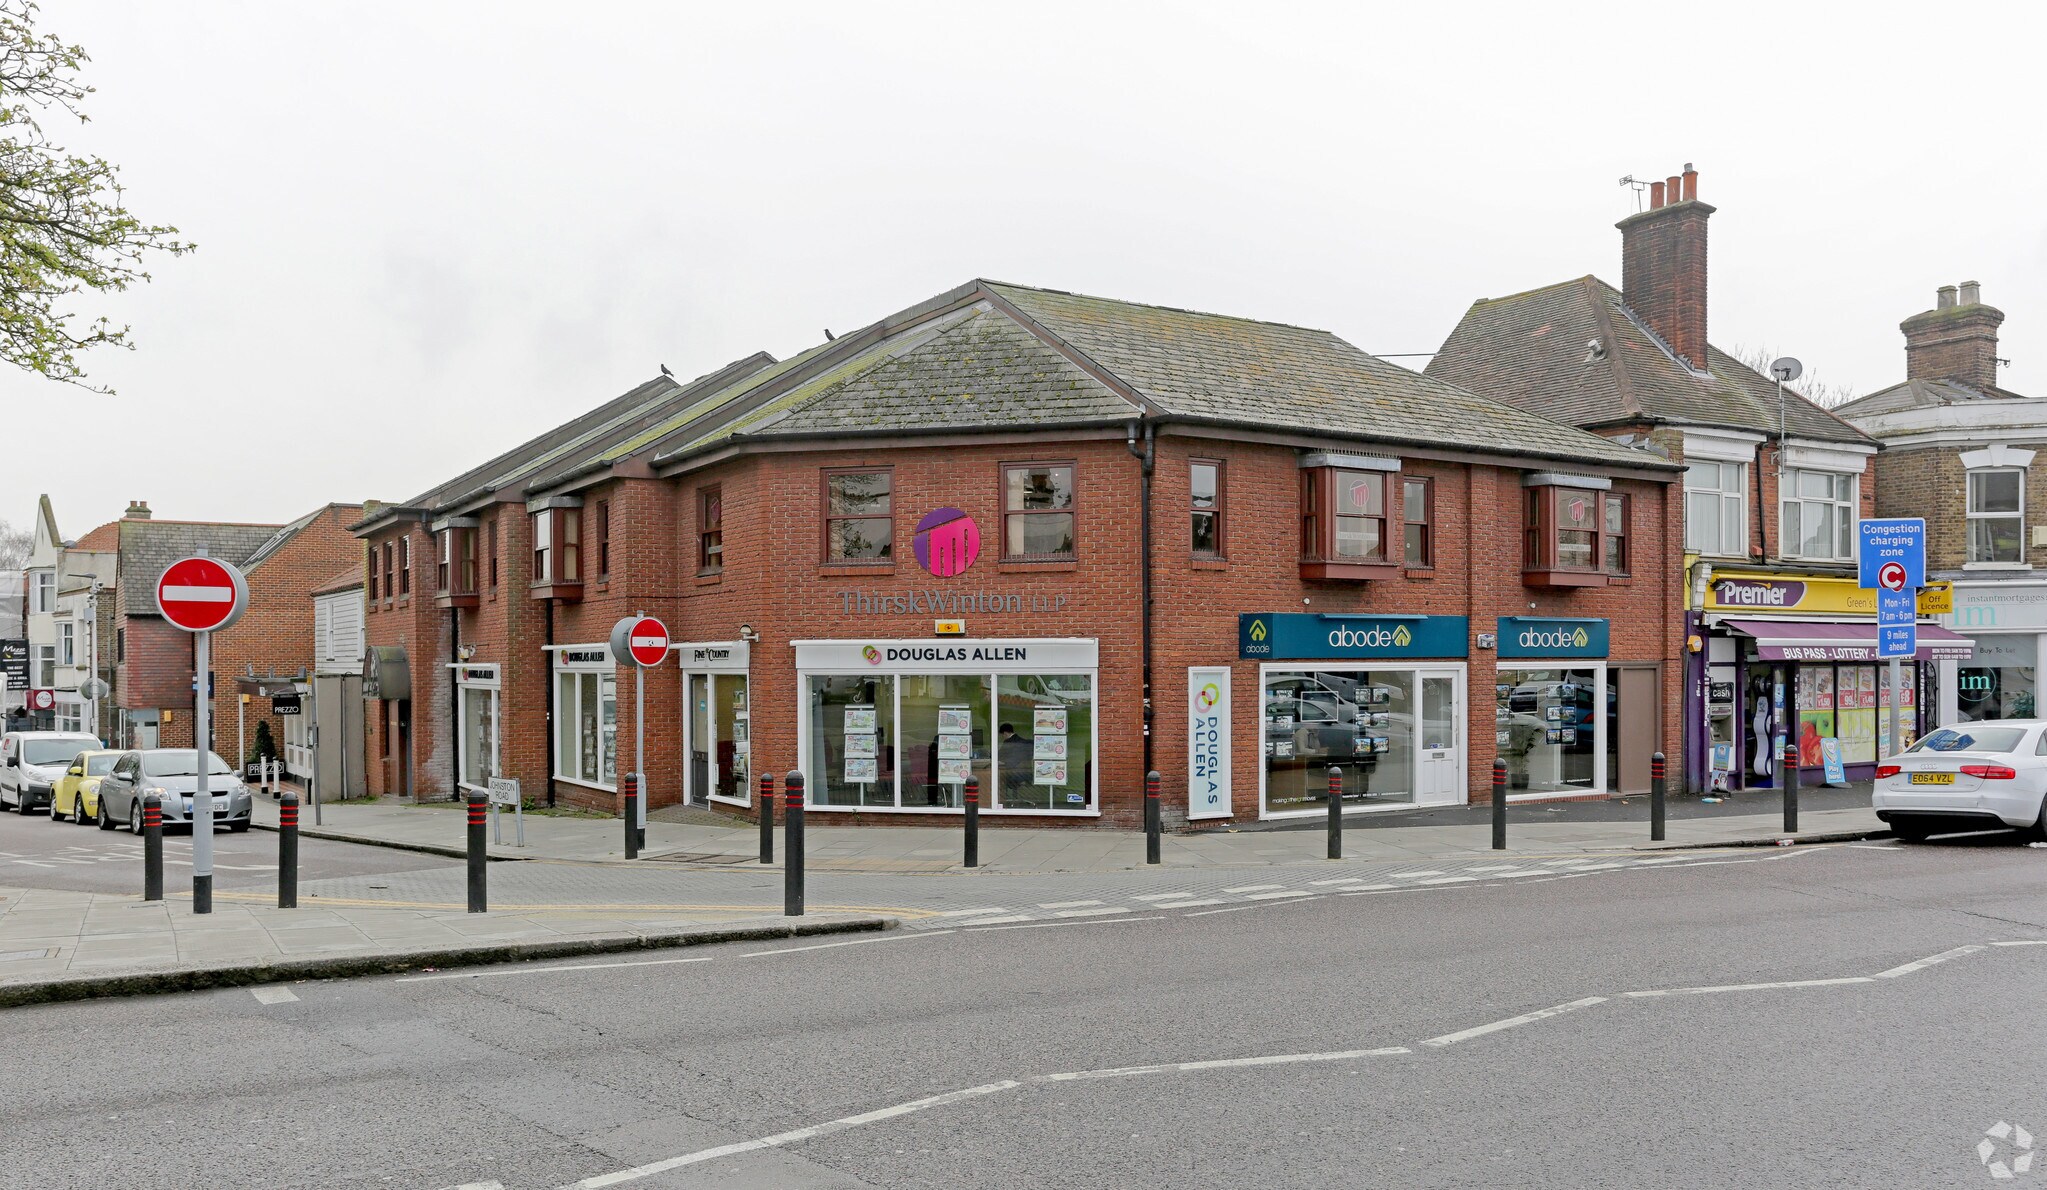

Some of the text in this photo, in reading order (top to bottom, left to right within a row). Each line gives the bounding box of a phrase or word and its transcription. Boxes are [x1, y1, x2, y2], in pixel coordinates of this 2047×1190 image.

[1863, 524, 1920, 535] Congestion
[1870, 536, 1914, 546] charging
[1880, 548, 1904, 557] zone
[1724, 581, 1787, 605] Premier
[1031, 594, 1066, 612] LLP
[1846, 597, 1874, 608] Green's
[1952, 597, 1998, 626] im
[1329, 624, 1392, 647] abode
[1519, 626, 1572, 648] abode
[1887, 630, 1909, 640] 9 miles
[1246, 643, 1270, 654] abode
[1889, 641, 1907, 651] ahead
[1980, 647, 1992, 655] Buy
[1995, 646, 2002, 654] To
[887, 647, 1026, 661] DOUGLAS ALLEN
[1783, 648, 1802, 659] BUS
[1804, 648, 1827, 659] PASS
[1834, 648, 1869, 660] LOTTERY
[1960, 670, 1991, 690] im
[1712, 686, 1730, 698] cash
[274, 705, 299, 714] PREZZO
[1195, 717, 1206, 777] ALLEN
[1208, 716, 1218, 804] DOUGLAS
[490, 780, 515, 791] JOHNSTON
[495, 790, 509, 800] ROAD
